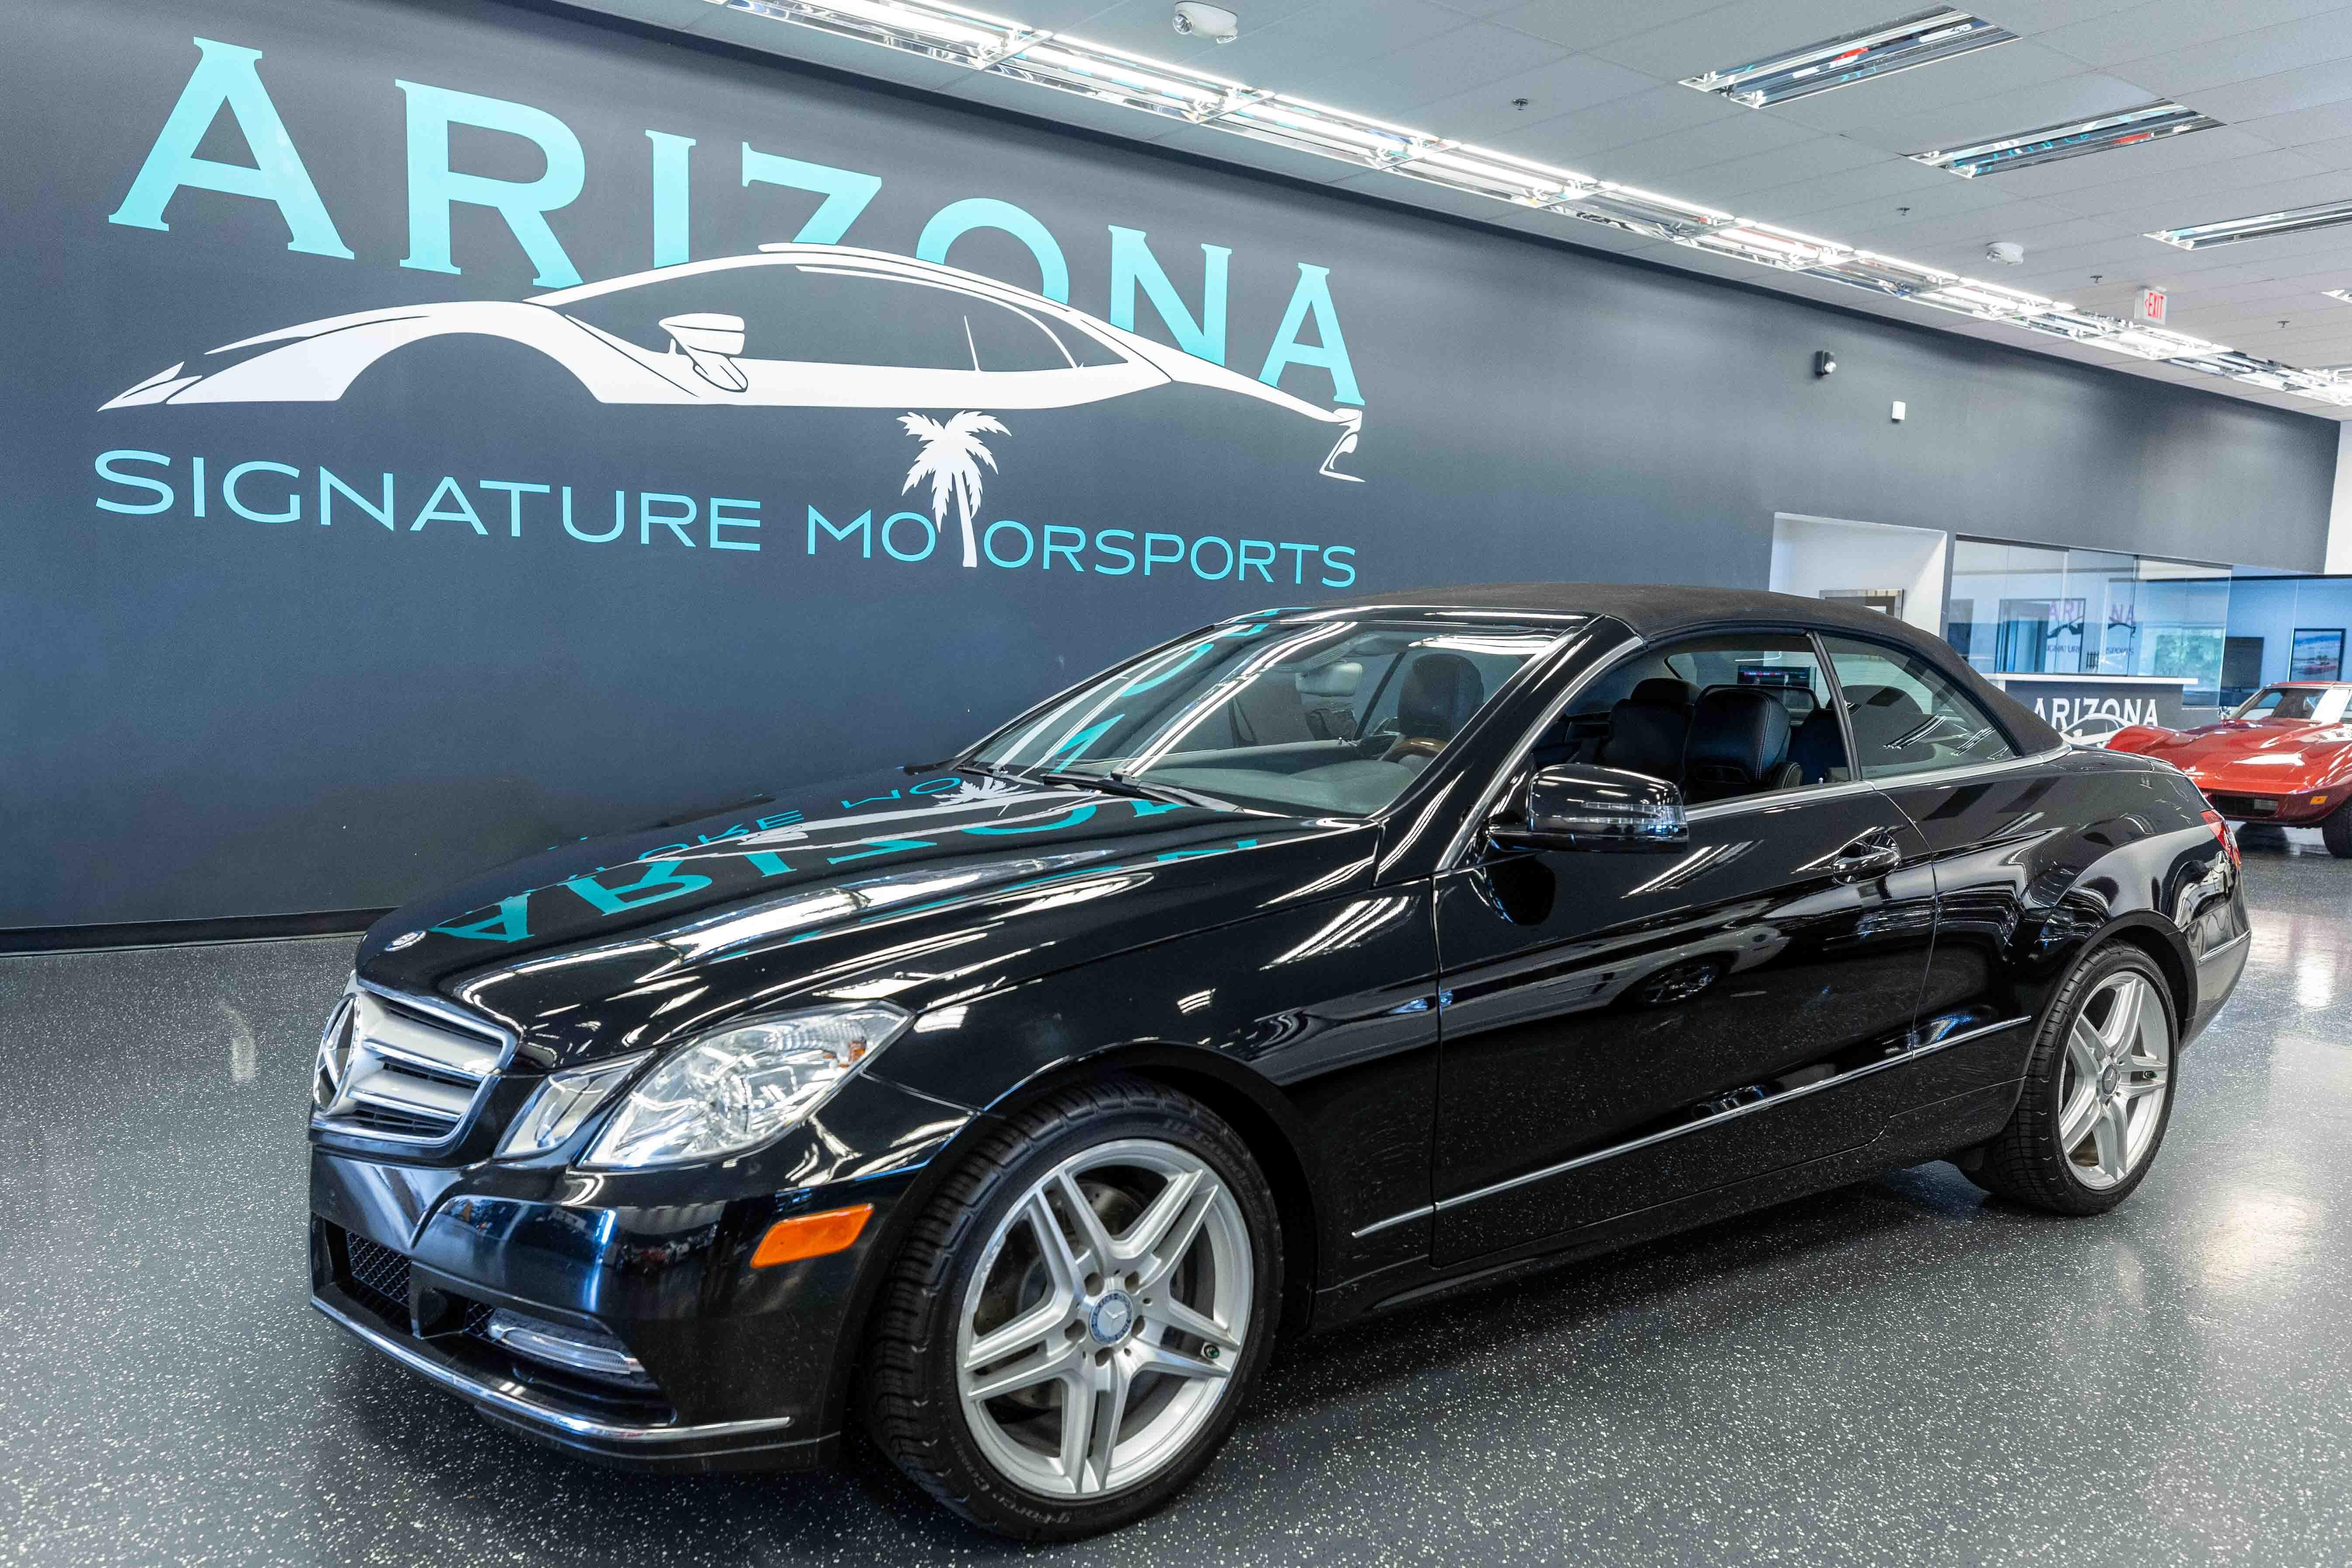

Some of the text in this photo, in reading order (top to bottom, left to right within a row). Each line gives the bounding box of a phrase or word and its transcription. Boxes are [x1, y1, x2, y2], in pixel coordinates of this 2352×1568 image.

[107, 37, 1365, 407] ARIZONA
[2148, 293, 2164, 319] EXIT
[95, 449, 1357, 587] SIGNATURE MOTORSPORTS
[2034, 698, 2159, 731] ARIZONA
